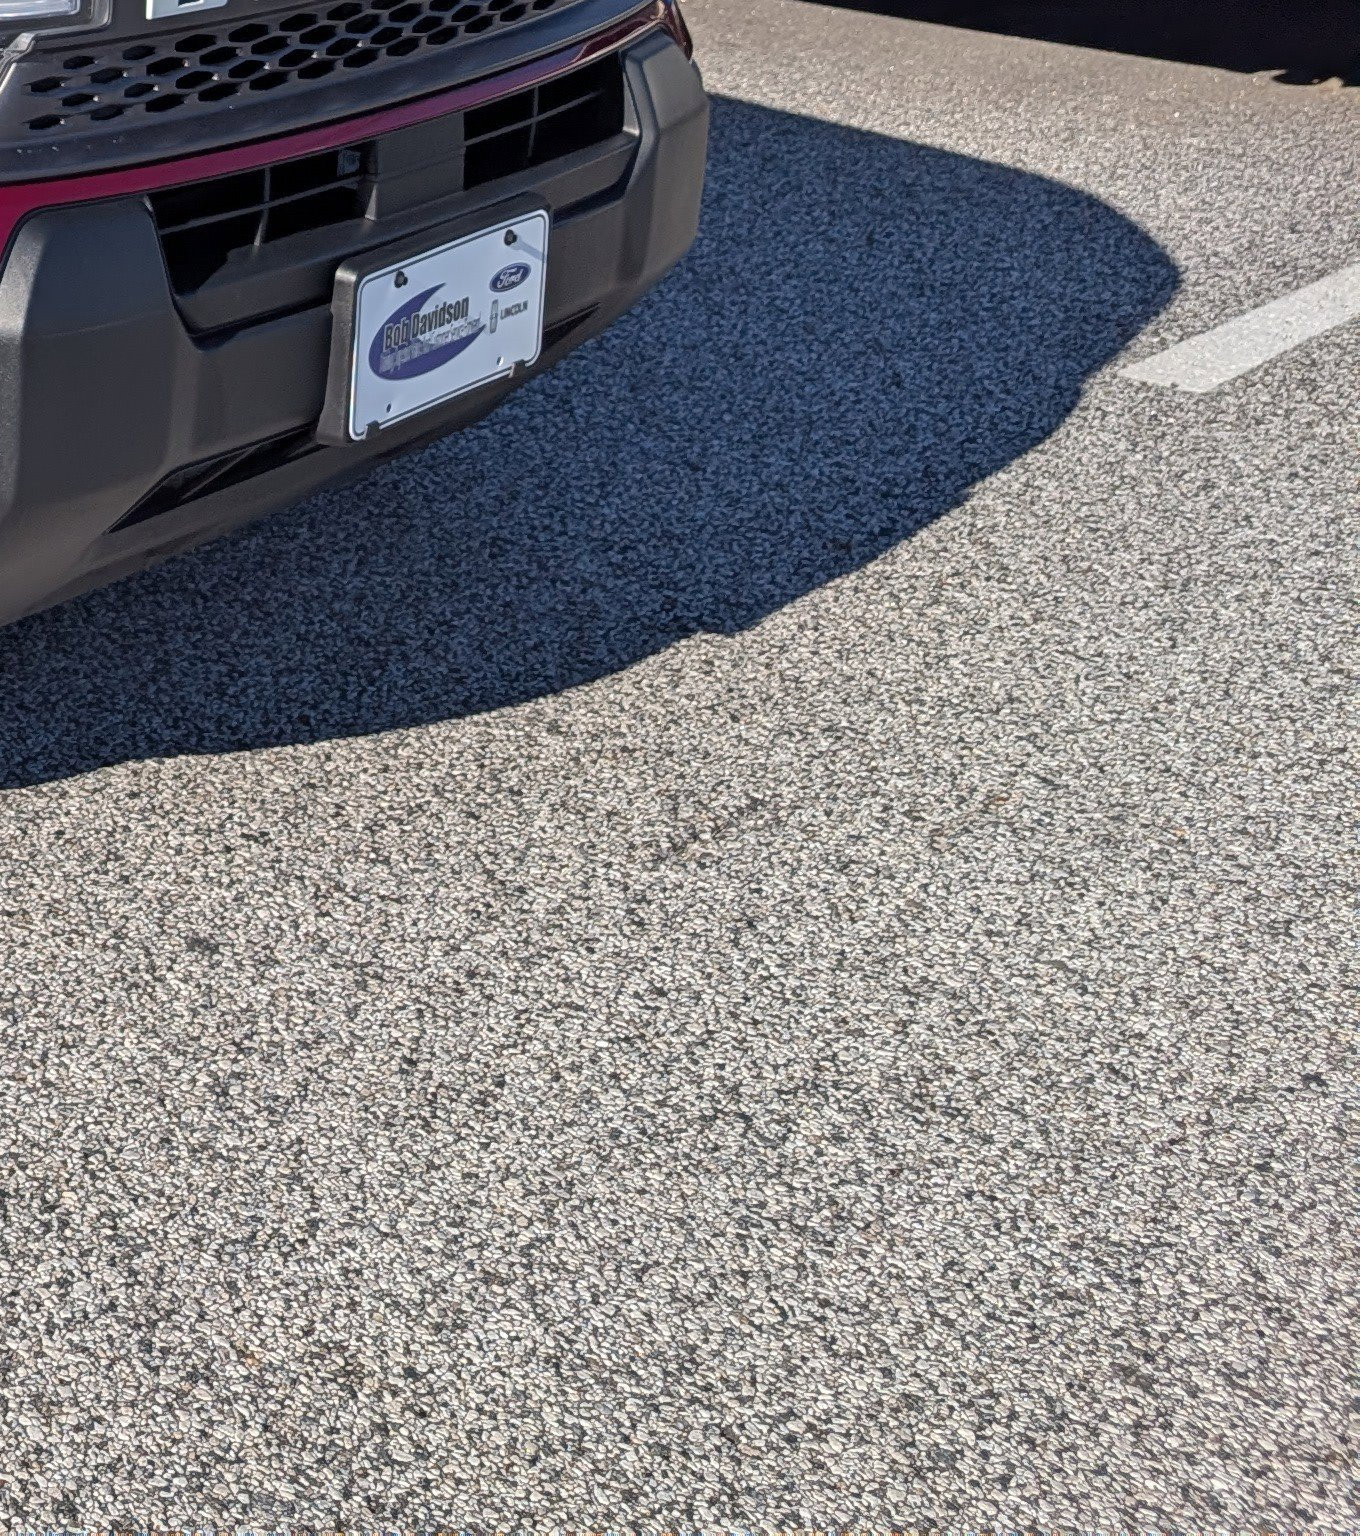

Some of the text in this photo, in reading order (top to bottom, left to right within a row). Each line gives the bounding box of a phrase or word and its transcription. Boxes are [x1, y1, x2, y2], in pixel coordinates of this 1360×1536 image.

[496, 267, 524, 289] Ford
[500, 300, 529, 321] LINCOLN
[384, 315, 412, 351] Bob
[411, 296, 470, 337] Davidson
